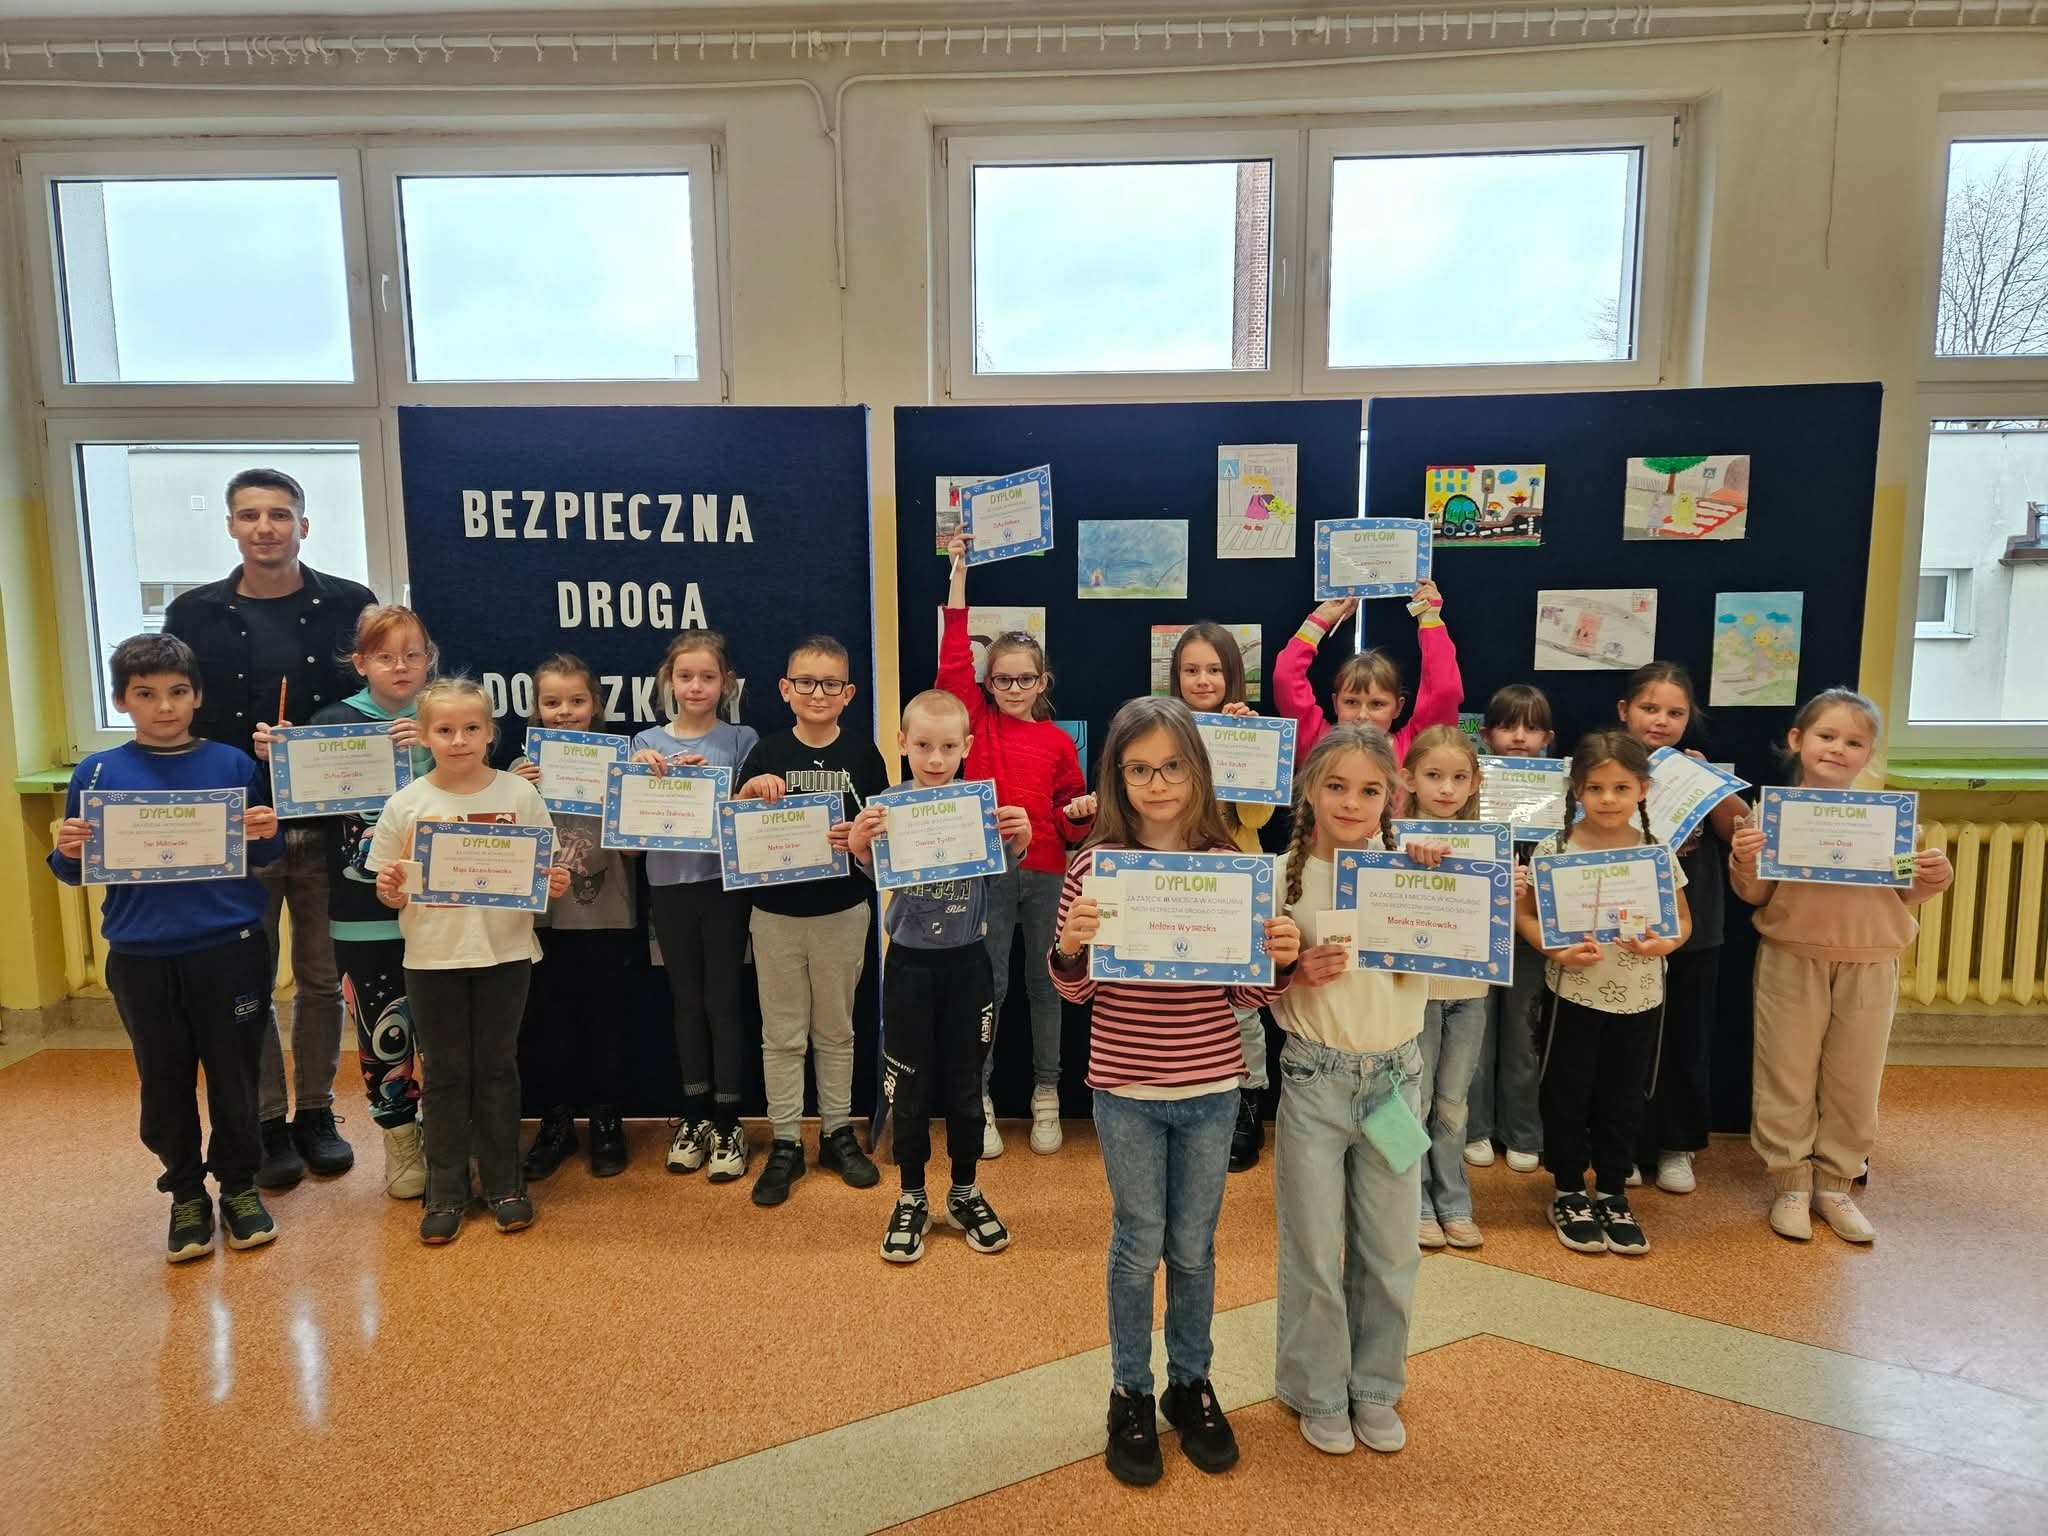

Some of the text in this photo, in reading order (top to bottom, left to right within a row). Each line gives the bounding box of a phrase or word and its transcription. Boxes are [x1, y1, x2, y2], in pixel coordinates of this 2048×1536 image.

[990, 488, 1022, 504] DYPLOM
[463, 490, 754, 543] BEZPIECZNA
[1354, 531, 1395, 542] DYPLOM
[557, 581, 708, 629] DROGA
[483, 672, 746, 724] DO ZKY
[1214, 729, 1257, 742] DYPLOM
[318, 739, 367, 753] DYPLOM
[563, 746, 598, 758] DYPLOM
[648, 779, 692, 791] DYPLOM
[785, 770, 850, 792] PUMA
[139, 806, 196, 819] DYPLOM
[761, 810, 806, 825] DYPLOM
[912, 802, 957, 818] DYPLOM
[1813, 806, 1867, 819] DYPLOM
[462, 837, 511, 849] DYPLOM
[1581, 865, 1630, 880] DYPLOM
[1155, 875, 1217, 892] DYPLOM
[1395, 873, 1456, 892] DYPLOM
[1387, 916, 1414, 926] Monika
